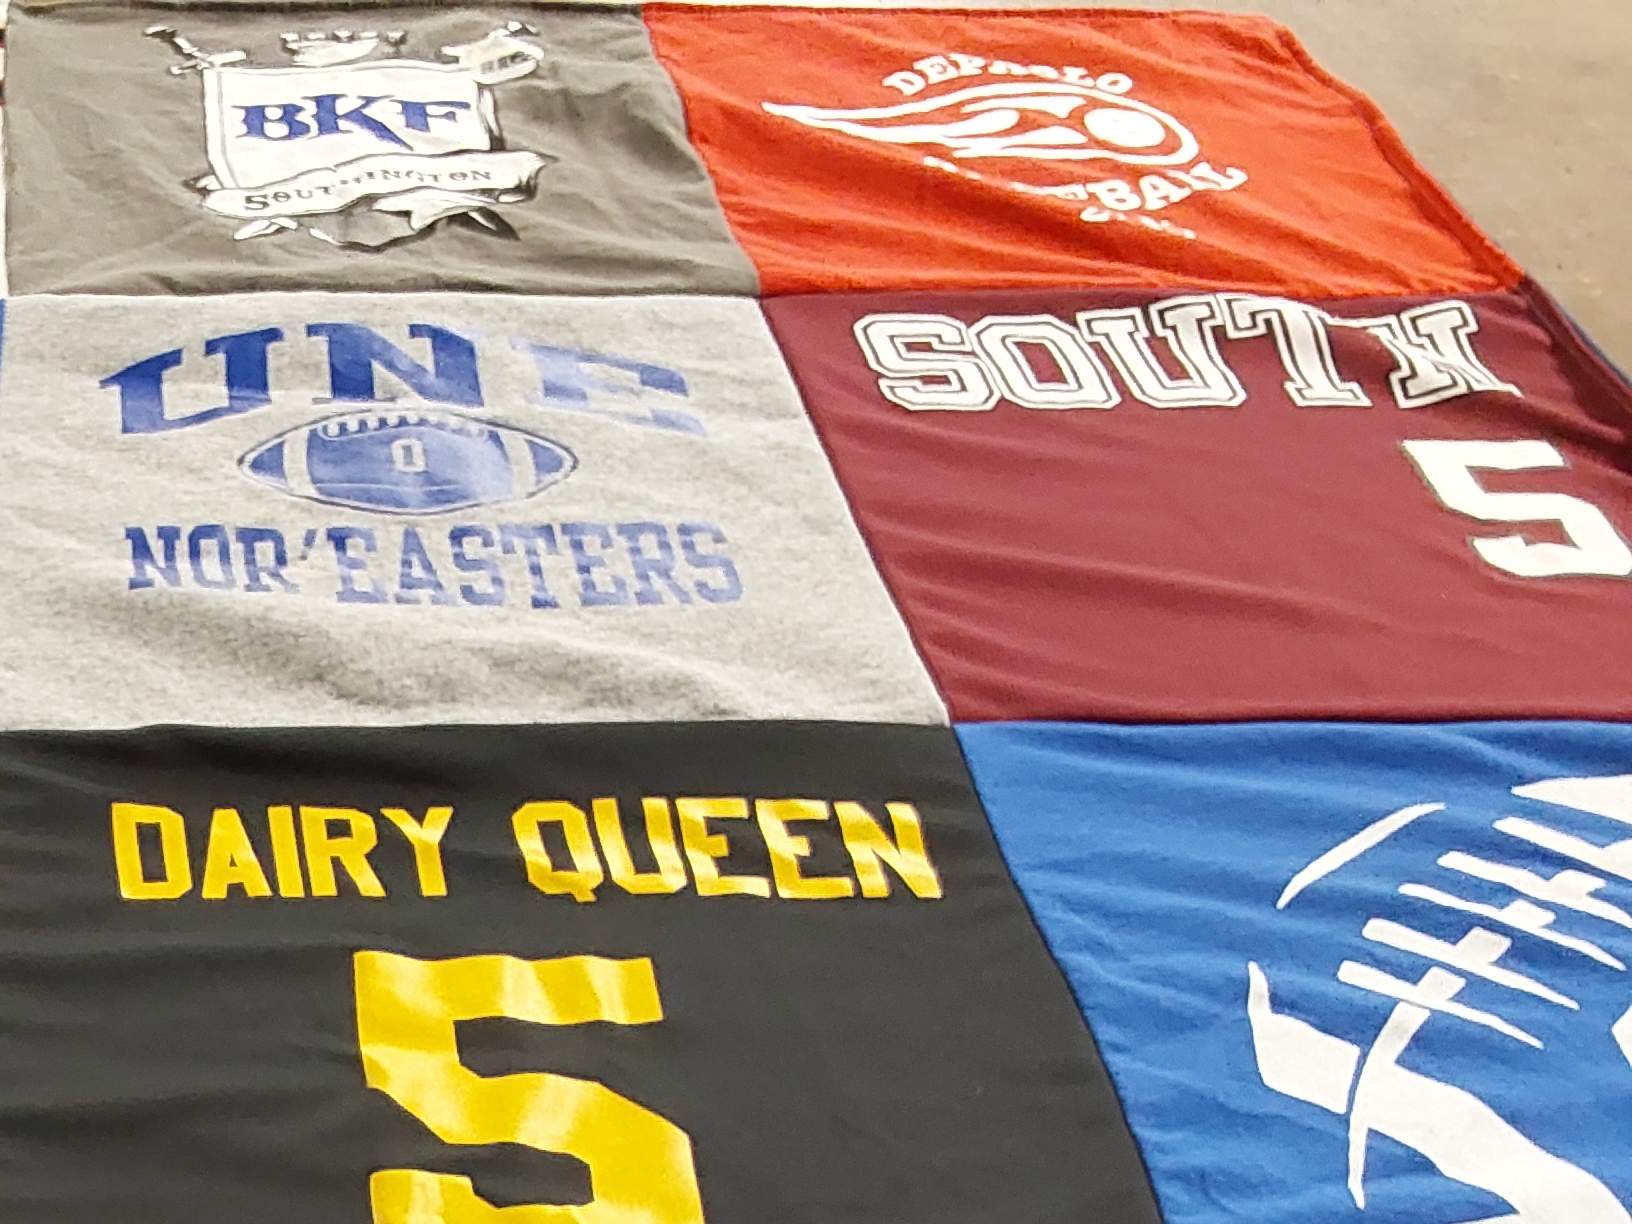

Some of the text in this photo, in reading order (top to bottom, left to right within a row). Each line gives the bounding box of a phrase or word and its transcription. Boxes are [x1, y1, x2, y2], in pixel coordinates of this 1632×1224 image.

[230, 93, 471, 150] BKF
[99, 323, 708, 436] UNE
[1401, 440, 1632, 577] 5
[124, 522, 744, 609] NOR'EASTERS
[111, 797, 943, 902] DAIRY QUEEN
